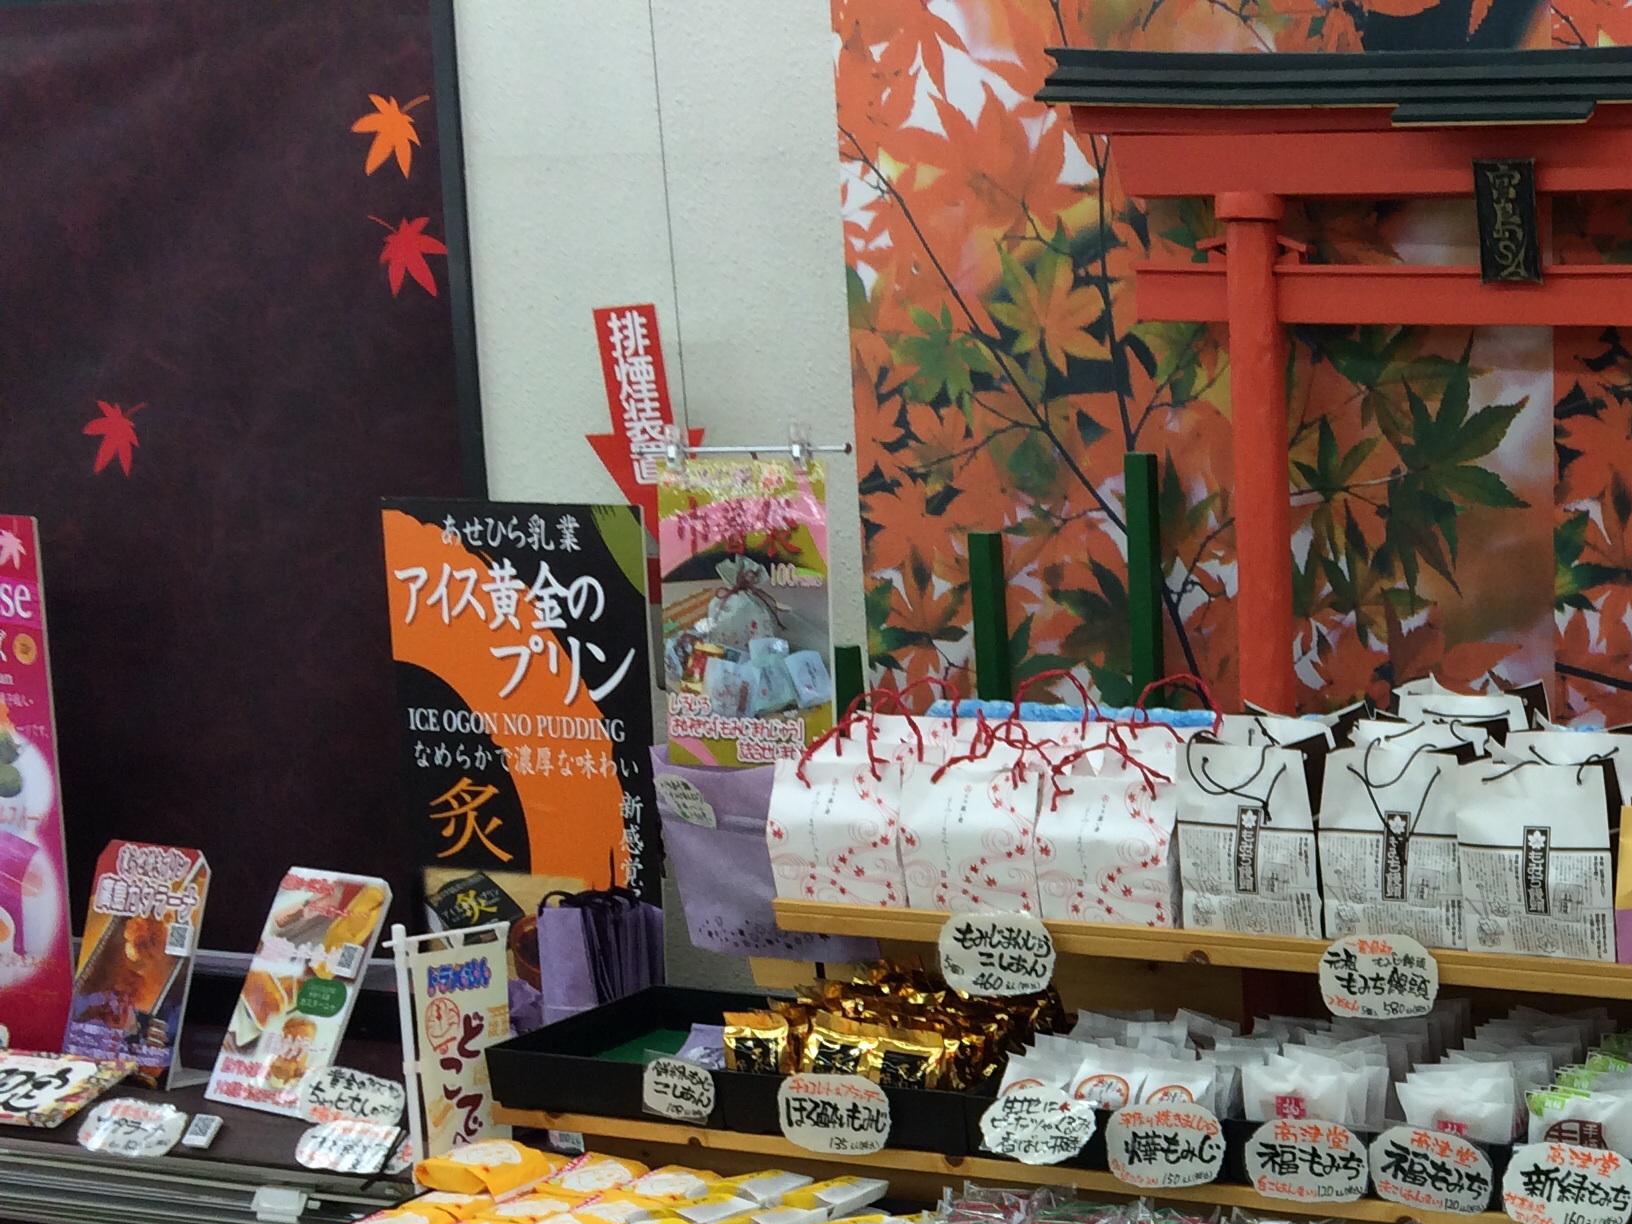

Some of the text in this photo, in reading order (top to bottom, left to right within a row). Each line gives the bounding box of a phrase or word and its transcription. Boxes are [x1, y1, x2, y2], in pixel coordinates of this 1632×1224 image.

[442, 514, 581, 552] あせひら乳業
[394, 558, 605, 631] アイス黄金の
[490, 636, 635, 705] プリン
[408, 708, 625, 743] ICE OGON NO PUDDING
[414, 741, 639, 778] なめらかで濃厚な味わい
[429, 777, 513, 862] 炙
[978, 951, 1046, 978] こしあん
[1383, 1002, 1405, 1015] 580
[830, 1136, 848, 1150] 135
[1256, 1141, 1365, 1180] 福もみぢ
[1162, 1173, 1180, 1185] 150
[1381, 1140, 1489, 1201] 福もみぢ
[1317, 1185, 1334, 1197] 120
[1444, 1198, 1460, 1211] 120
